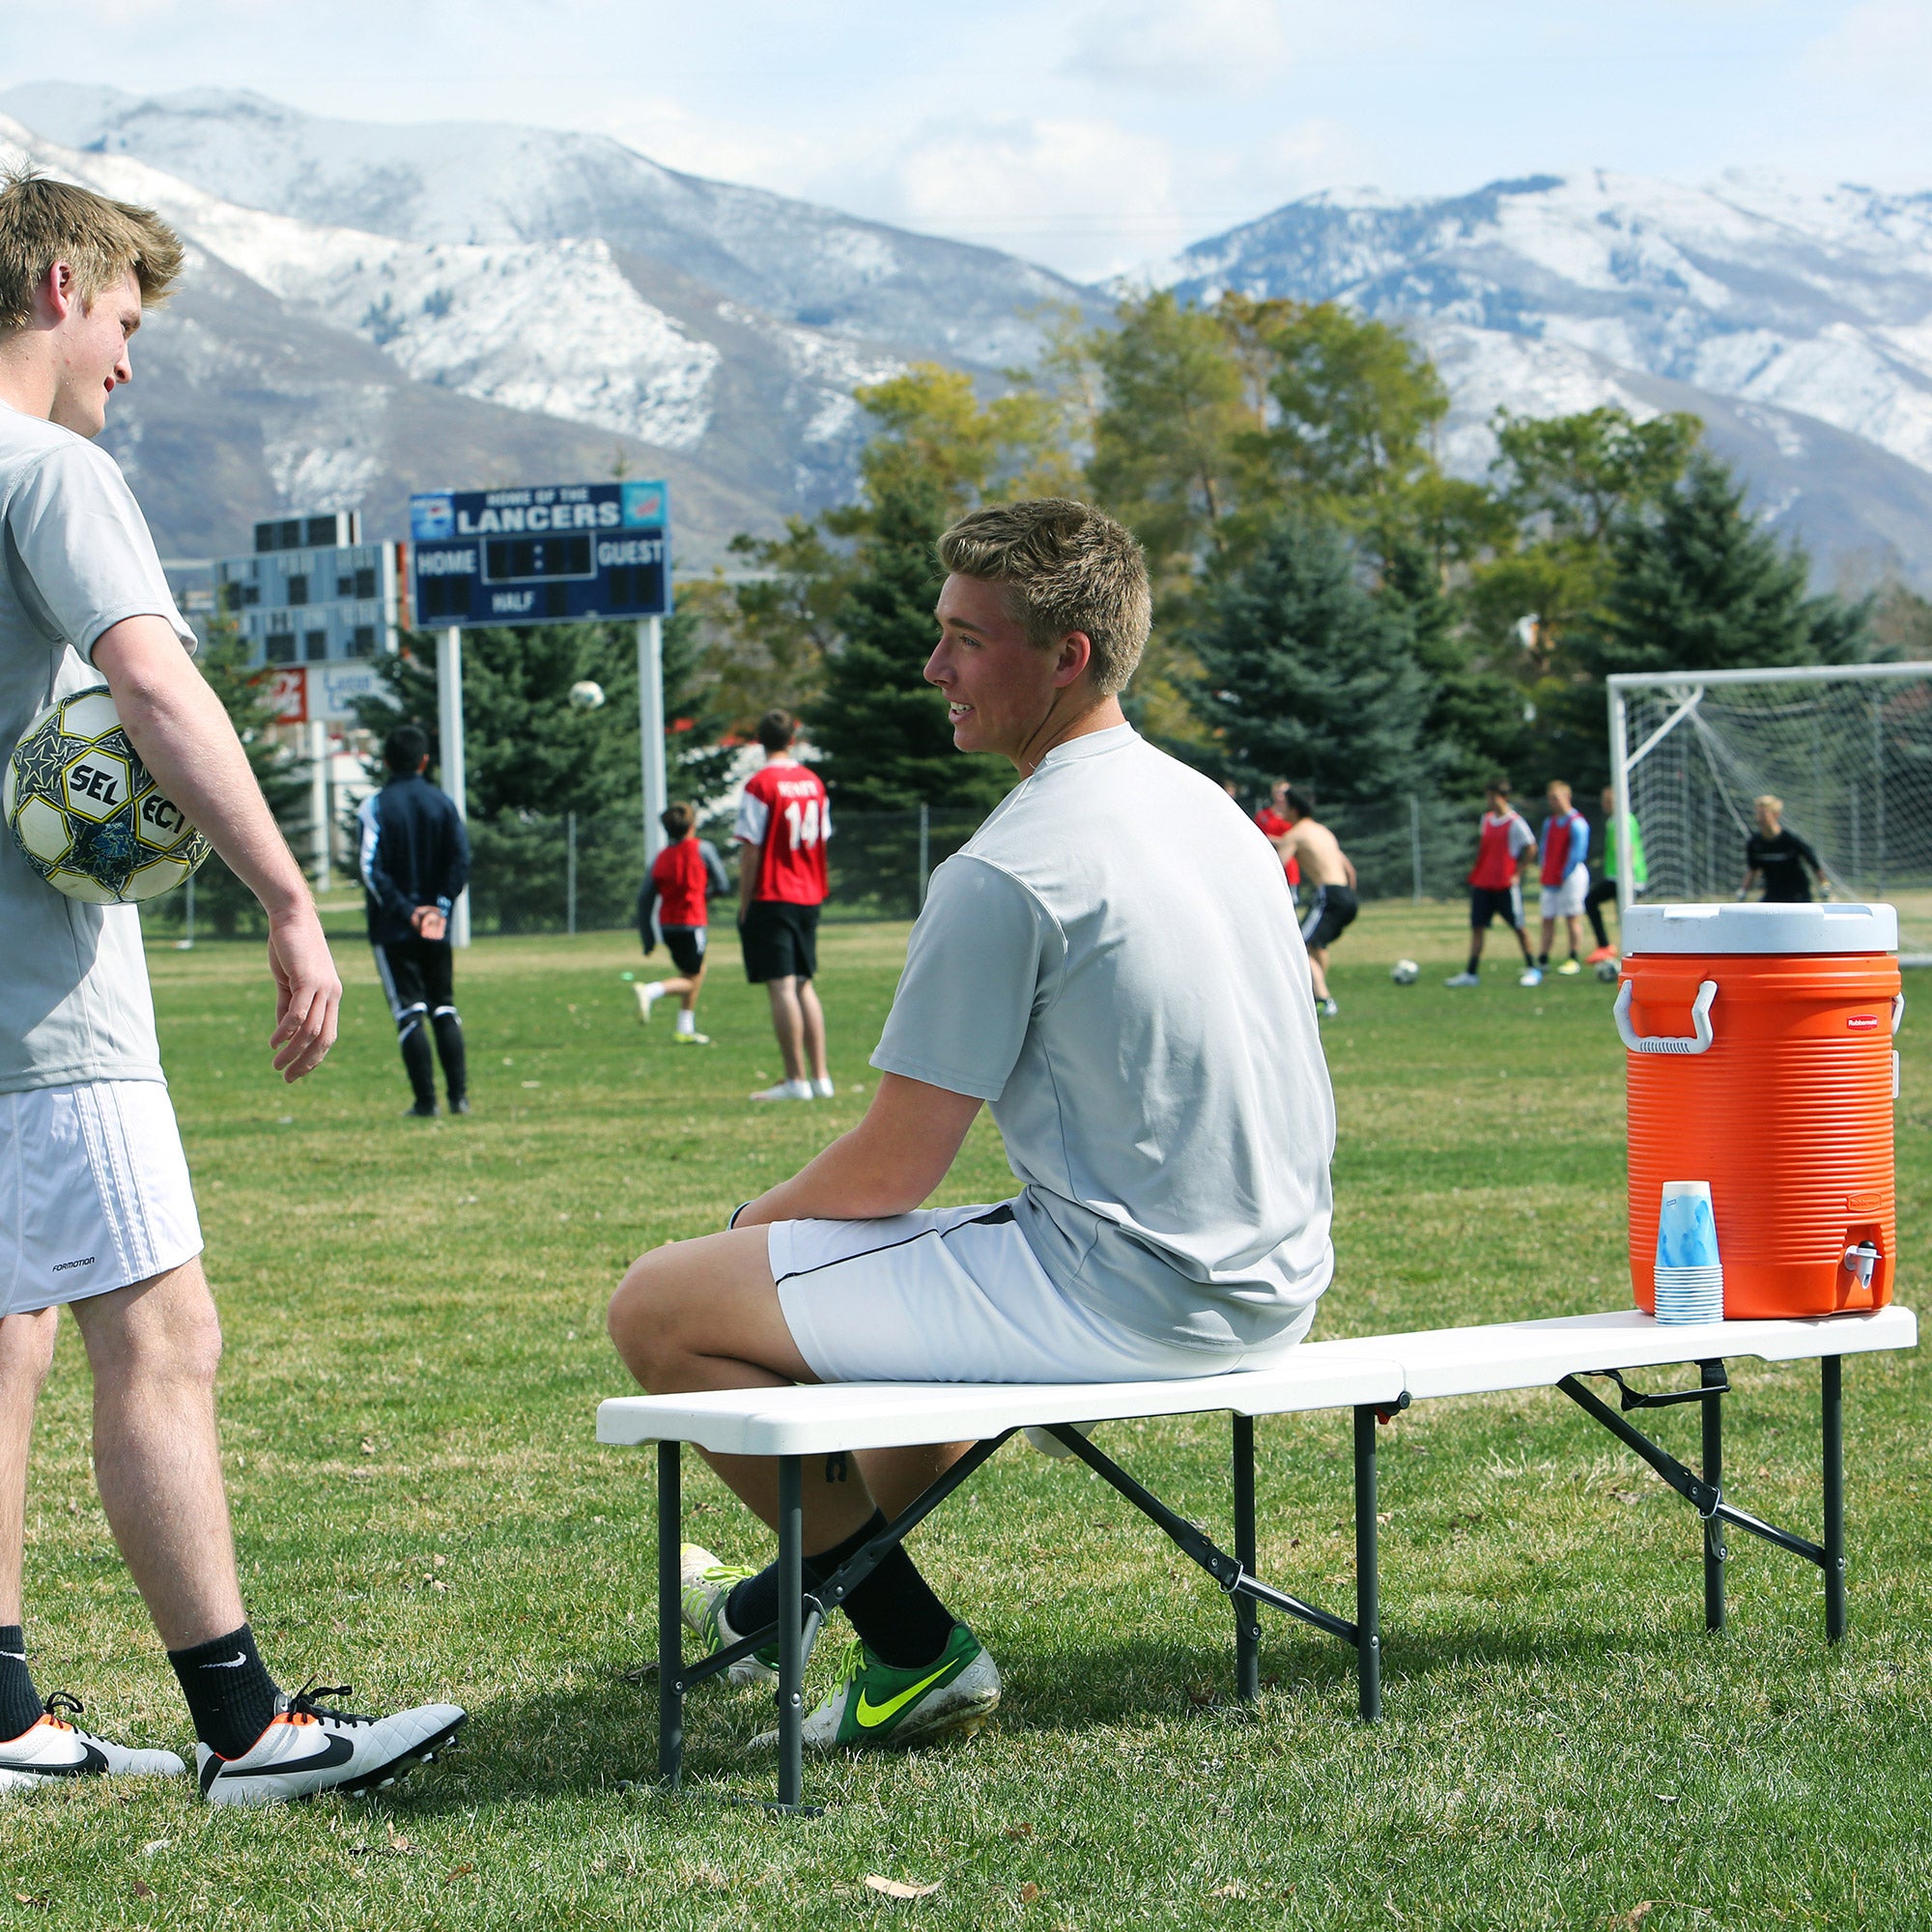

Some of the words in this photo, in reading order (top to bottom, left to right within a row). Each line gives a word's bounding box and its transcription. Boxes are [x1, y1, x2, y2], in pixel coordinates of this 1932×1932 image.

[534, 489, 555, 503] OF
[560, 487, 588, 501] THE
[458, 501, 620, 533] LANCERS
[418, 550, 476, 575] HOME
[598, 540, 663, 565] GUEST
[493, 591, 534, 611] HALF
[70, 764, 120, 807] SEL
[783, 799, 819, 850] 14
[52, 1256, 95, 1272] FORMOTION
